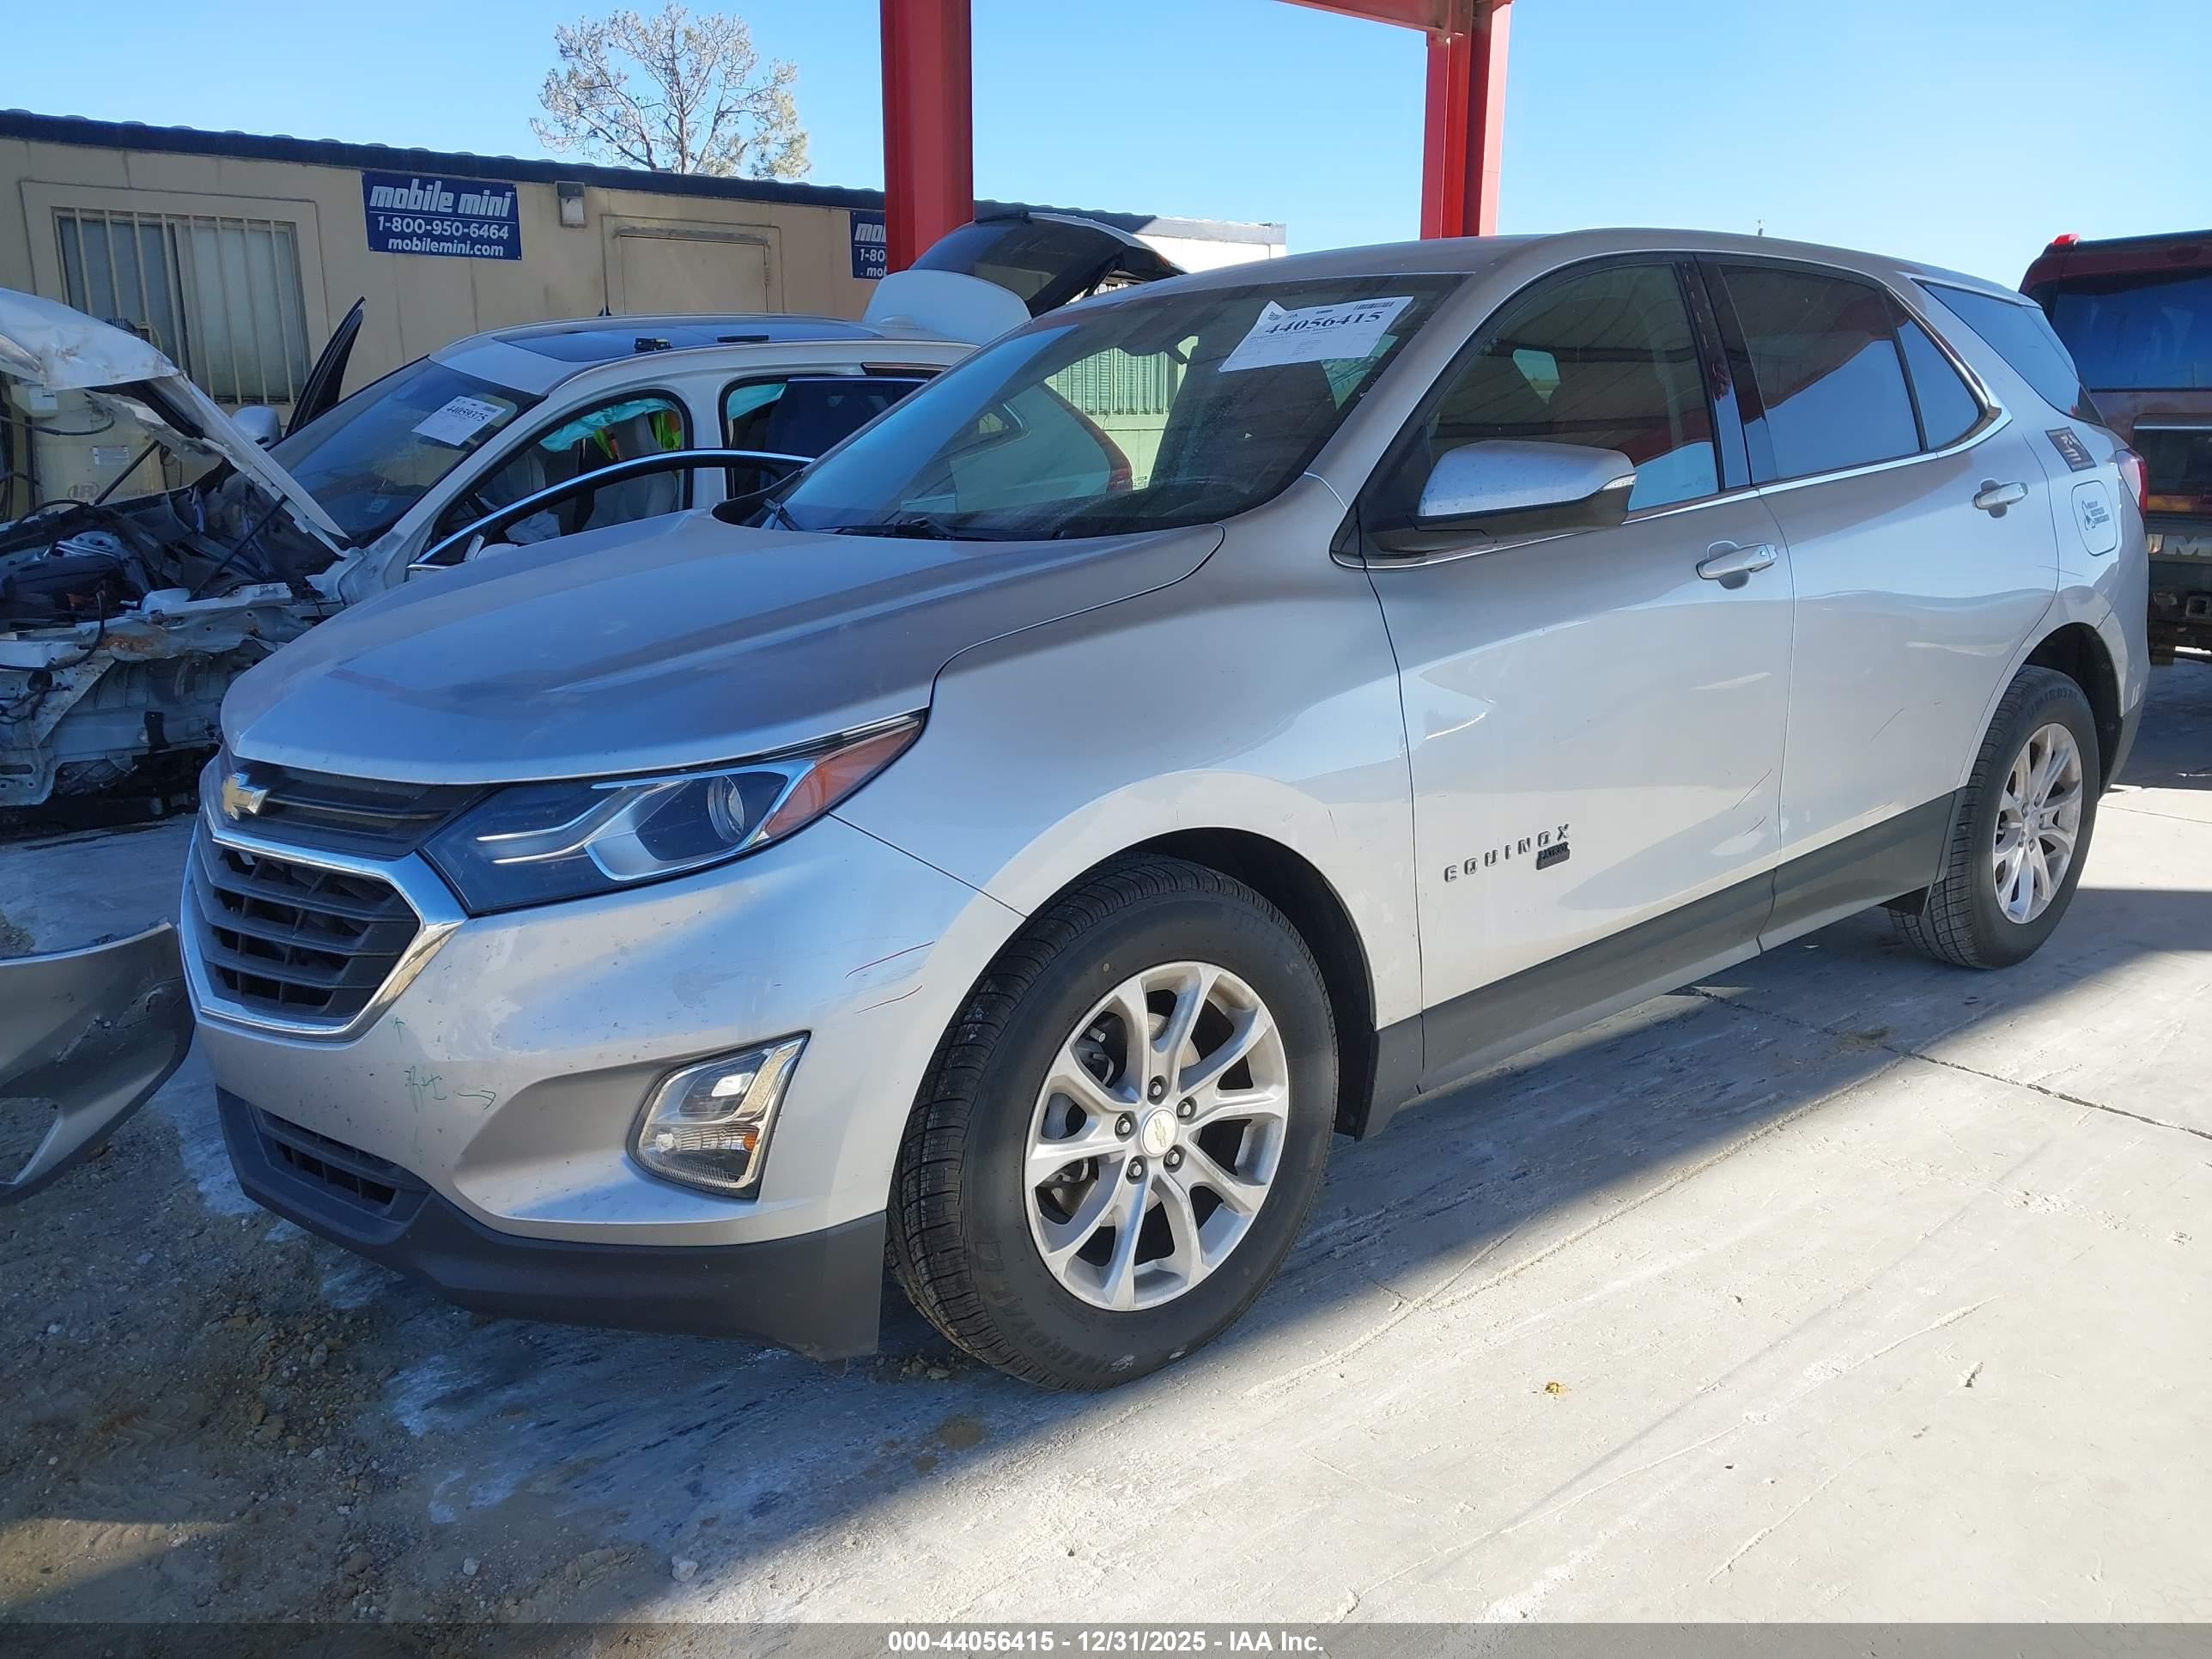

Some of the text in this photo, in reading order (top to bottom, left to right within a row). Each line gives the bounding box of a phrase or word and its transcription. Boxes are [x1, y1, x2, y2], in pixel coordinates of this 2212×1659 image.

[370, 179, 511, 217] mobile mini
[378, 216, 508, 240] 1-800-950-6464
[388, 237, 504, 257] mobilemini.com
[1264, 310, 1384, 335] 44056415
[1444, 823, 1570, 883] EQUINOX
